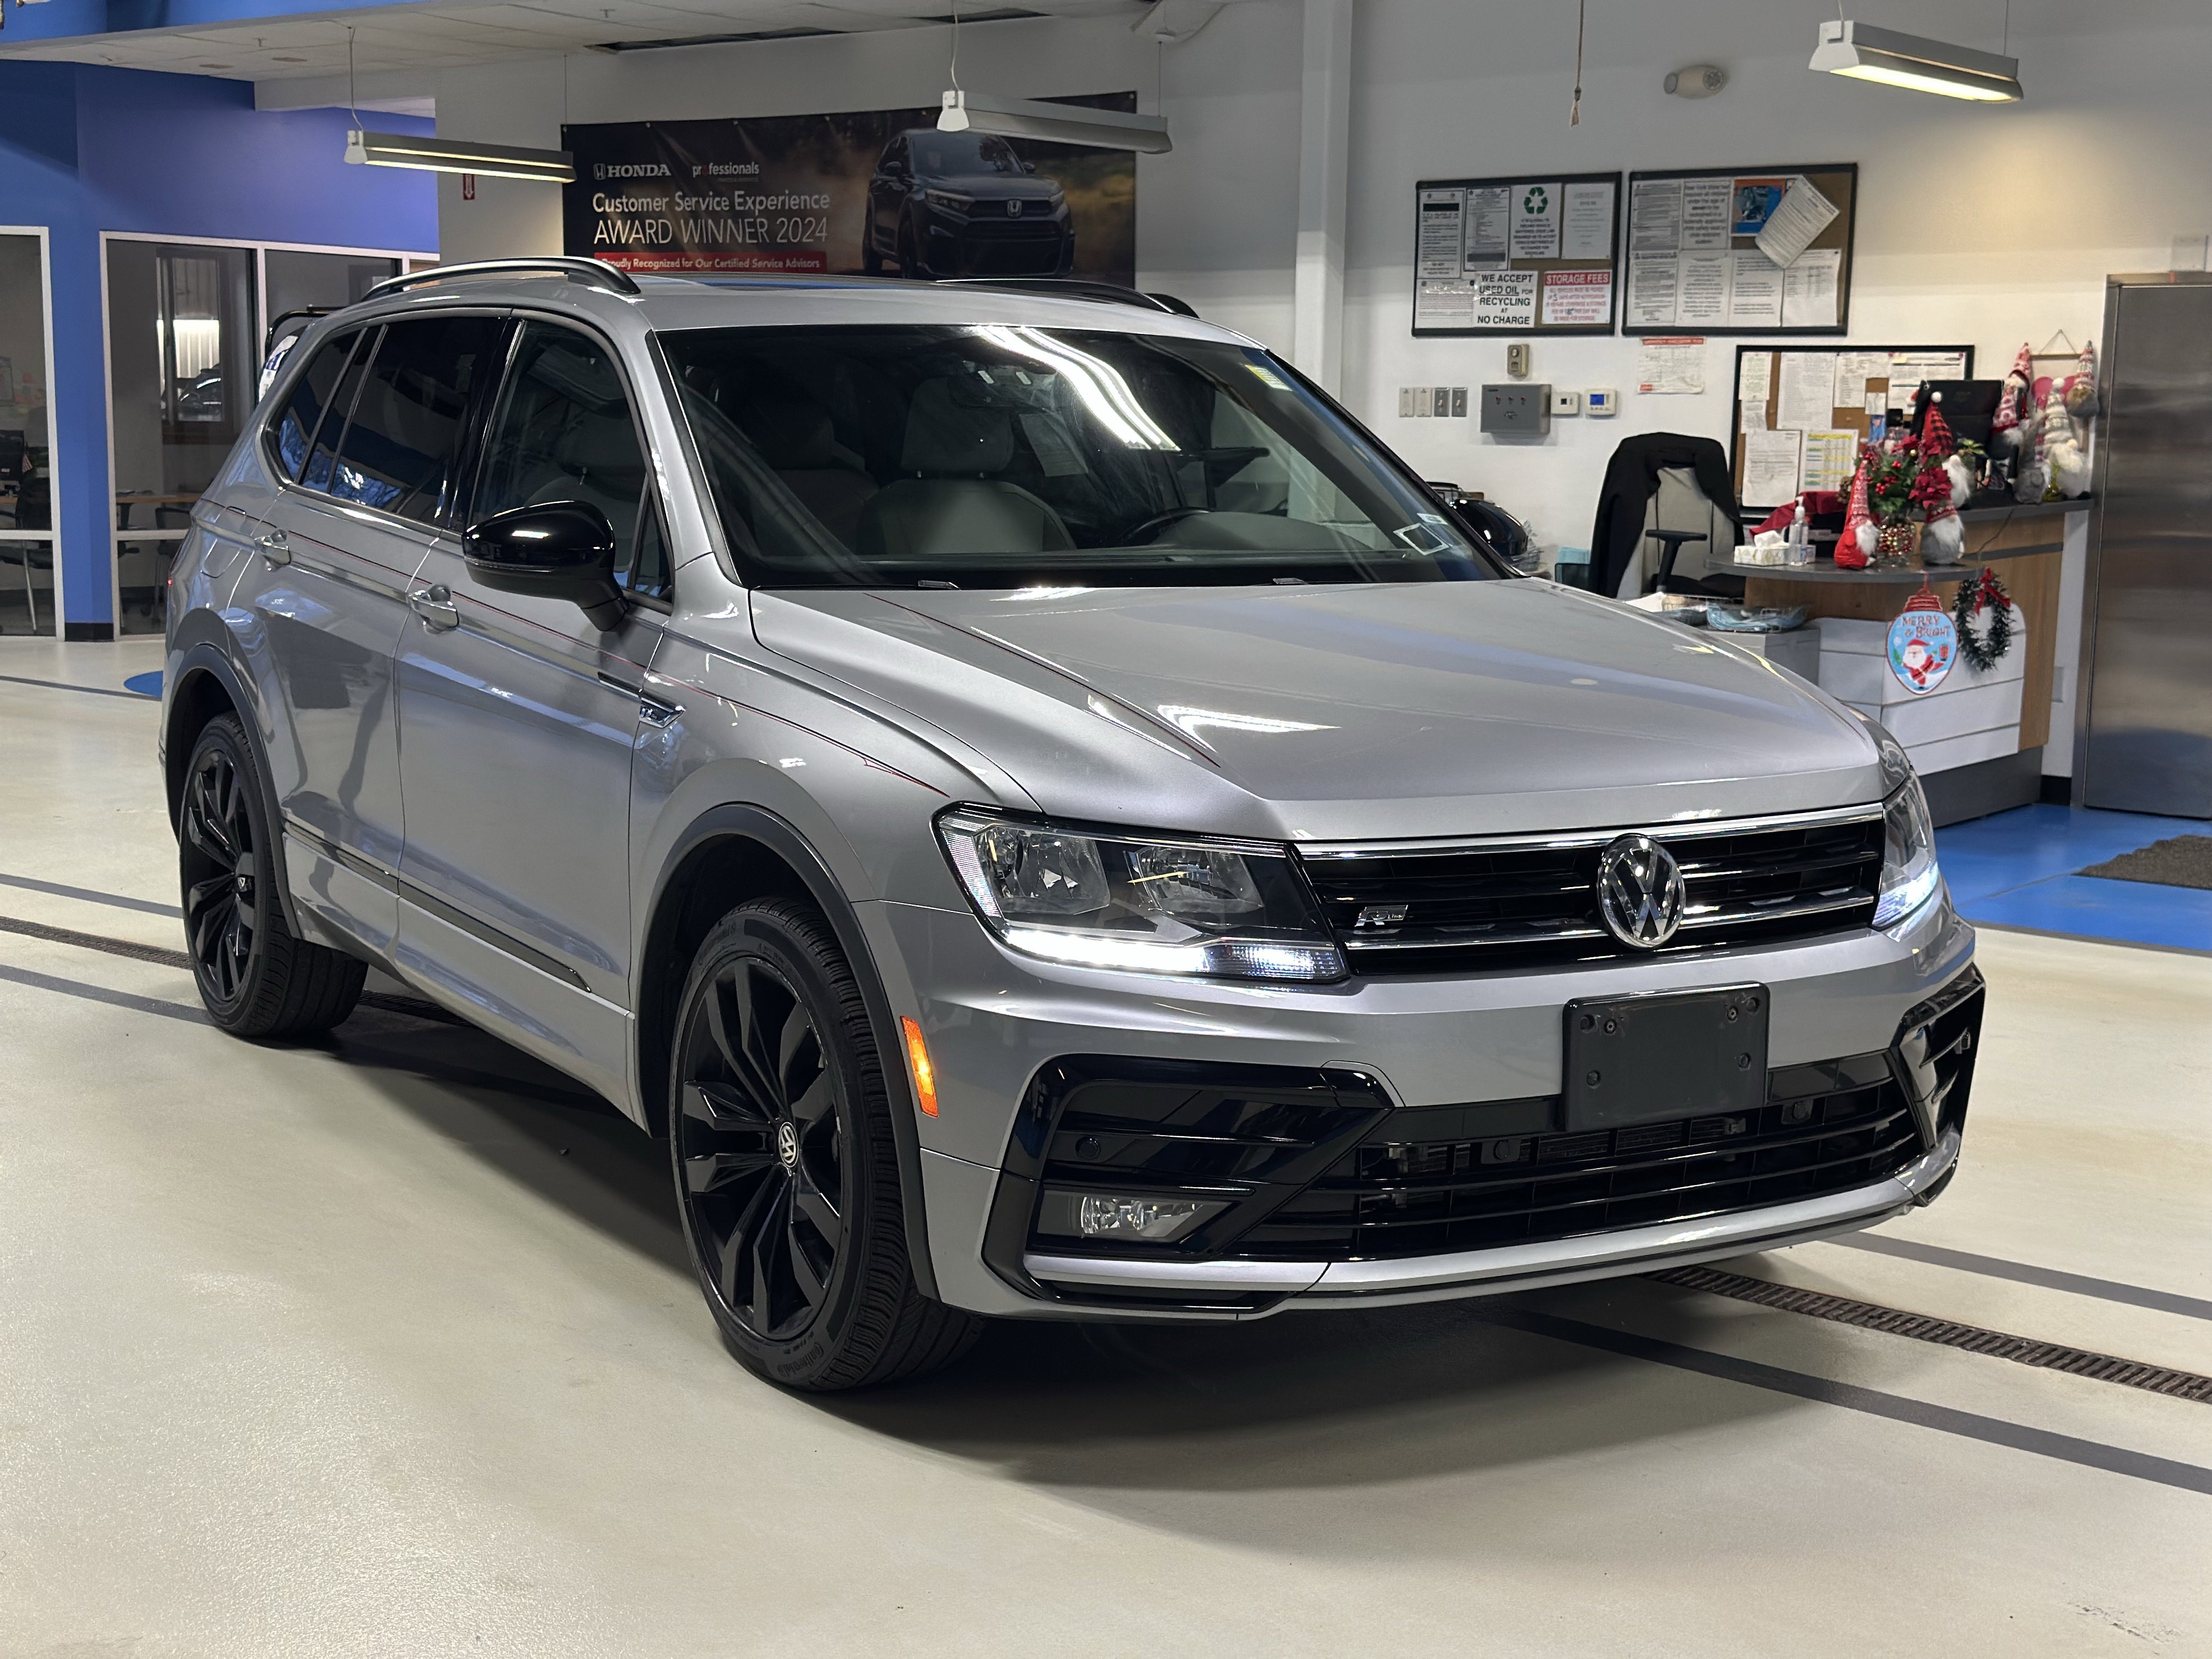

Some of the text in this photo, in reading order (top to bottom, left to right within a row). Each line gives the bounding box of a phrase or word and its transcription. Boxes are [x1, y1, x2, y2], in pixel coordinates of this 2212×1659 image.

[607, 164, 672, 178] HONDA
[592, 190, 830, 216] Customer Service Experience
[594, 217, 828, 244] AWARD WINNER 2024
[602, 257, 820, 270] oudly Recognized for Our Certified Service Advisors
[1481, 274, 1533, 283] WE ACCEPT
[1546, 273, 1609, 284] STORAGE FEES
[1479, 285, 1503, 294] USED
[1505, 285, 1519, 295] OIL
[1480, 297, 1531, 306] RECYCLING
[1477, 315, 1530, 325] NO CHARGE
[1902, 615, 1940, 626] MERRY
[1916, 625, 1951, 638] BRIGHT
